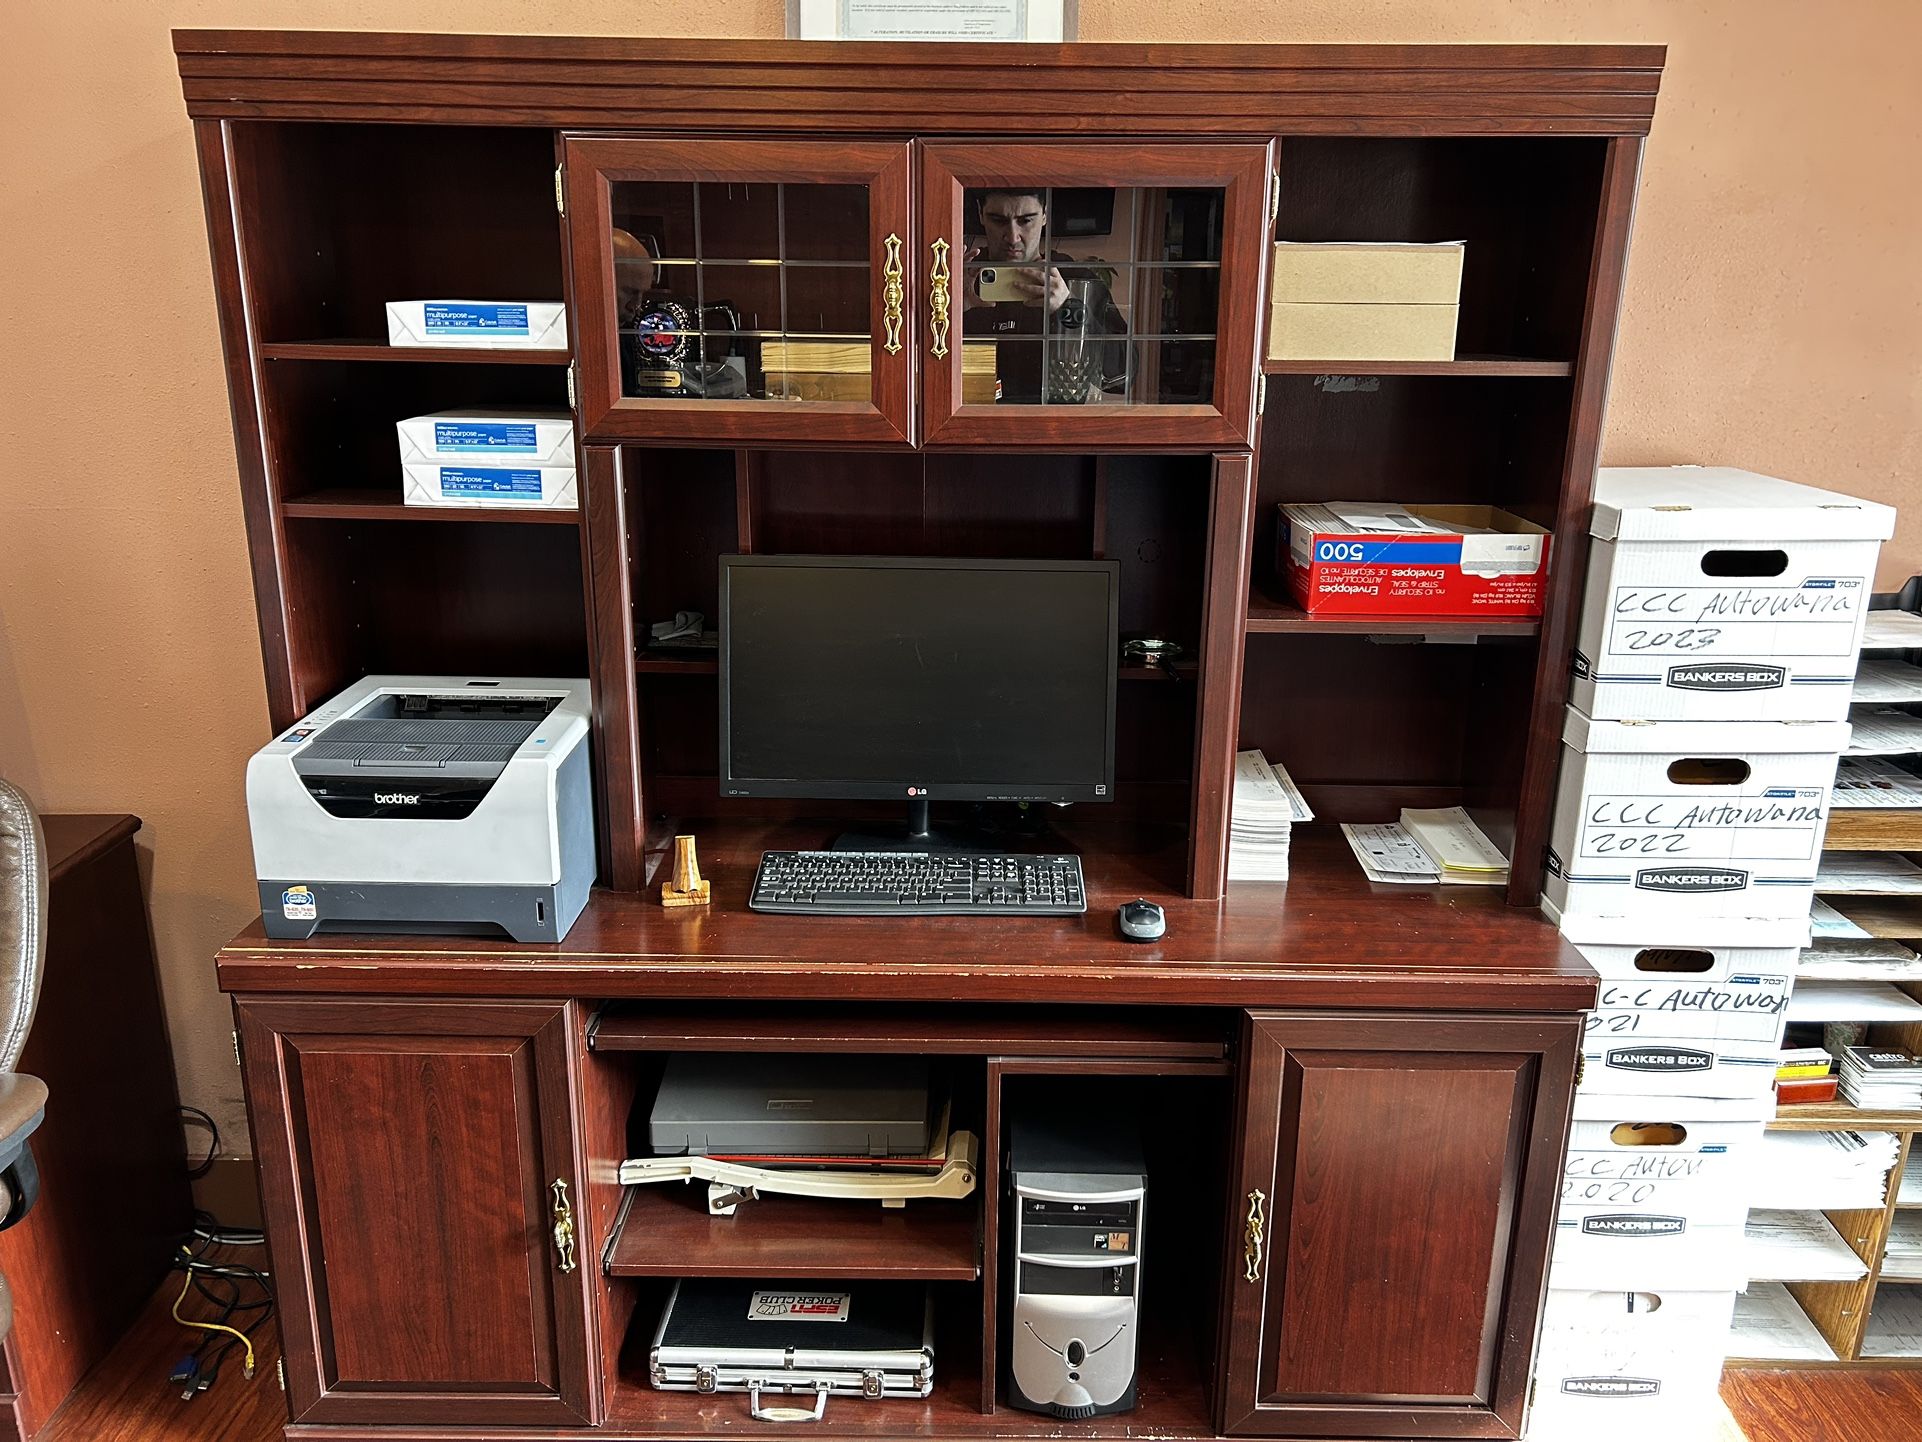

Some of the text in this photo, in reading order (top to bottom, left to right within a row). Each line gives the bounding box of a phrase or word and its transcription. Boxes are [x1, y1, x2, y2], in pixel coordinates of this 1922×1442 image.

[426, 311, 468, 319] multipurpose
[1320, 543, 1364, 561] 500
[1391, 568, 1445, 579] Envelopes
[1320, 575, 1383, 584] AUTOCOLLANTES
[1392, 580, 1408, 588] SEAL
[1319, 583, 1379, 596] Enveloppes
[1389, 588, 1423, 596] SECURITY
[1625, 628, 1721, 651] 2023
[1673, 672, 1779, 683] BANKERS BOX
[374, 793, 419, 804] brother
[1591, 833, 1691, 853] 2022
[1641, 874, 1743, 885] BANKERS BOX
[1612, 1053, 1706, 1066] BANKERS BOX
[1588, 1221, 1681, 1230] BANKERS BOX
[760, 1296, 843, 1305] POKER CLUB
[790, 1304, 840, 1314] ESPN
